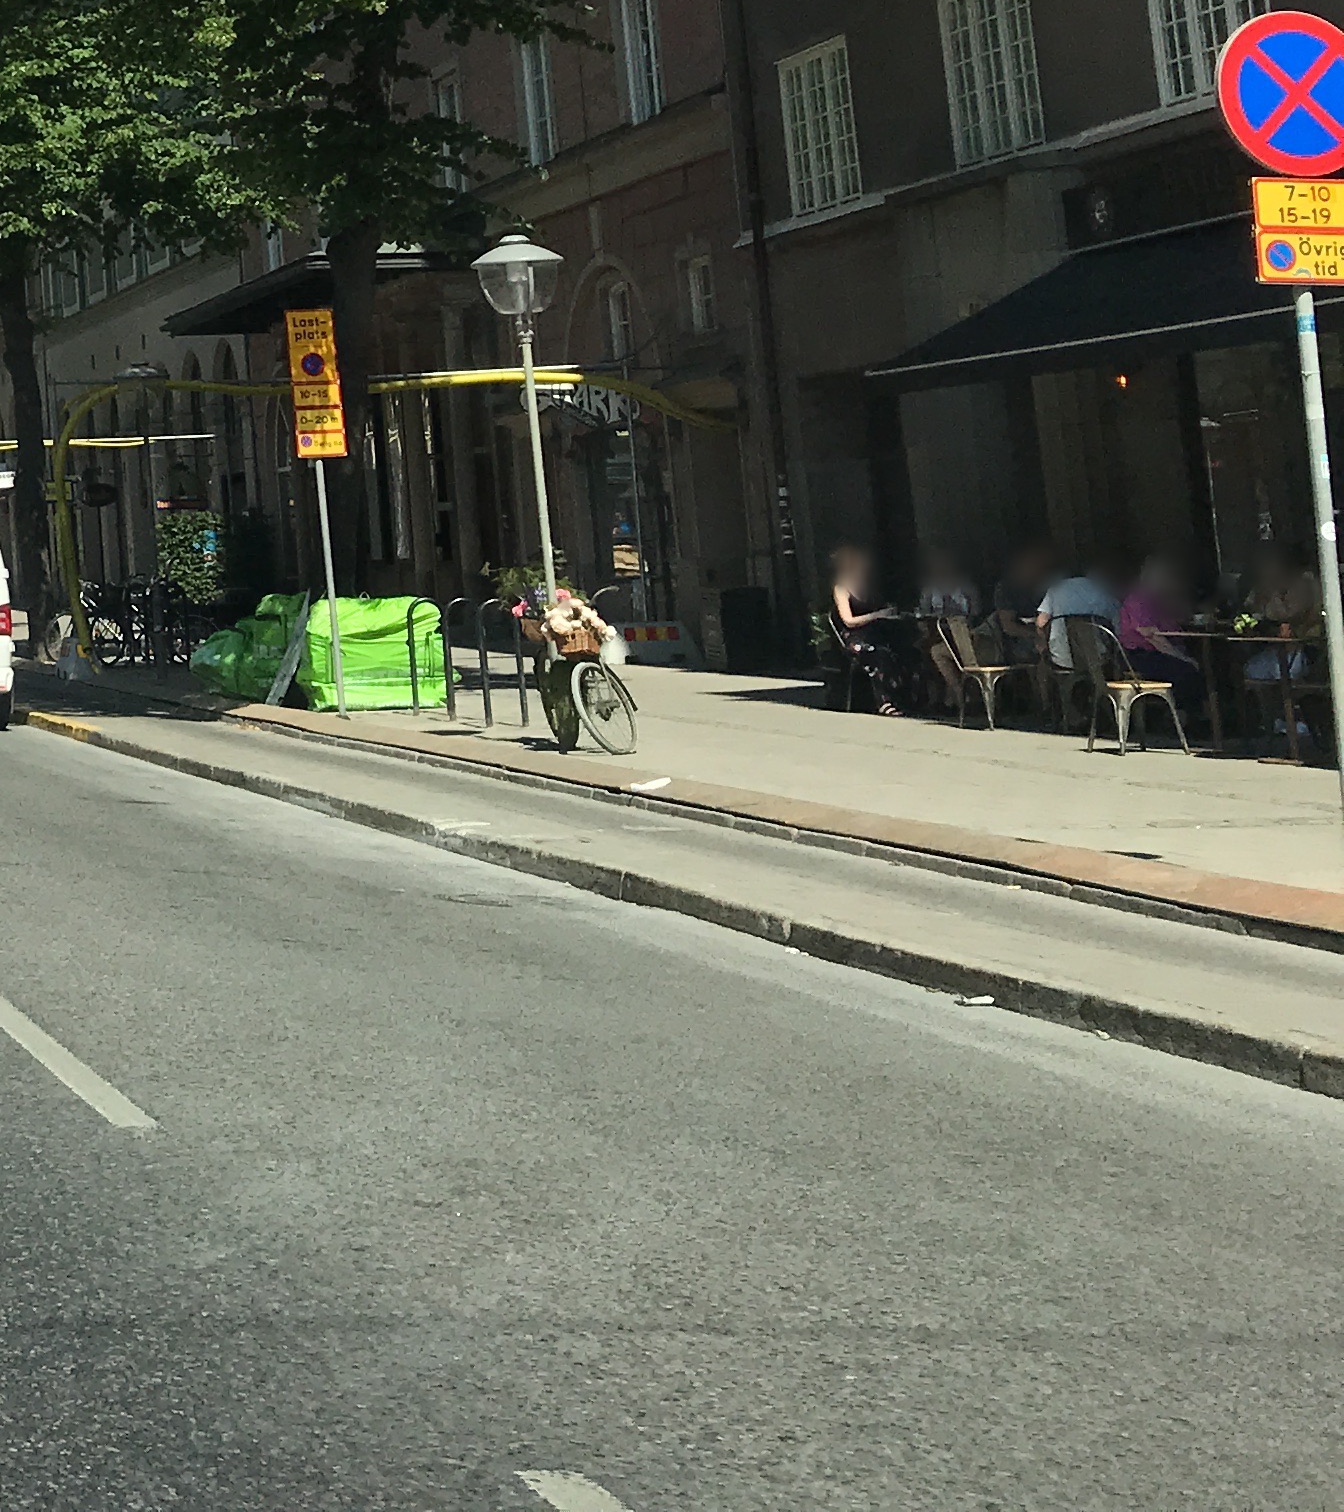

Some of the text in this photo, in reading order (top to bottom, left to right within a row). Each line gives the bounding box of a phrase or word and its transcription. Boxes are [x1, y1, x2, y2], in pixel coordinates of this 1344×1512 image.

[1284, 185, 1330, 202] 7-10
[1279, 207, 1331, 224] 15-19
[1314, 260, 1338, 276] tid
[292, 317, 327, 327] Last-
[295, 330, 328, 341] plats
[300, 389, 328, 398] 10-15
[300, 416, 328, 424] 0-20
